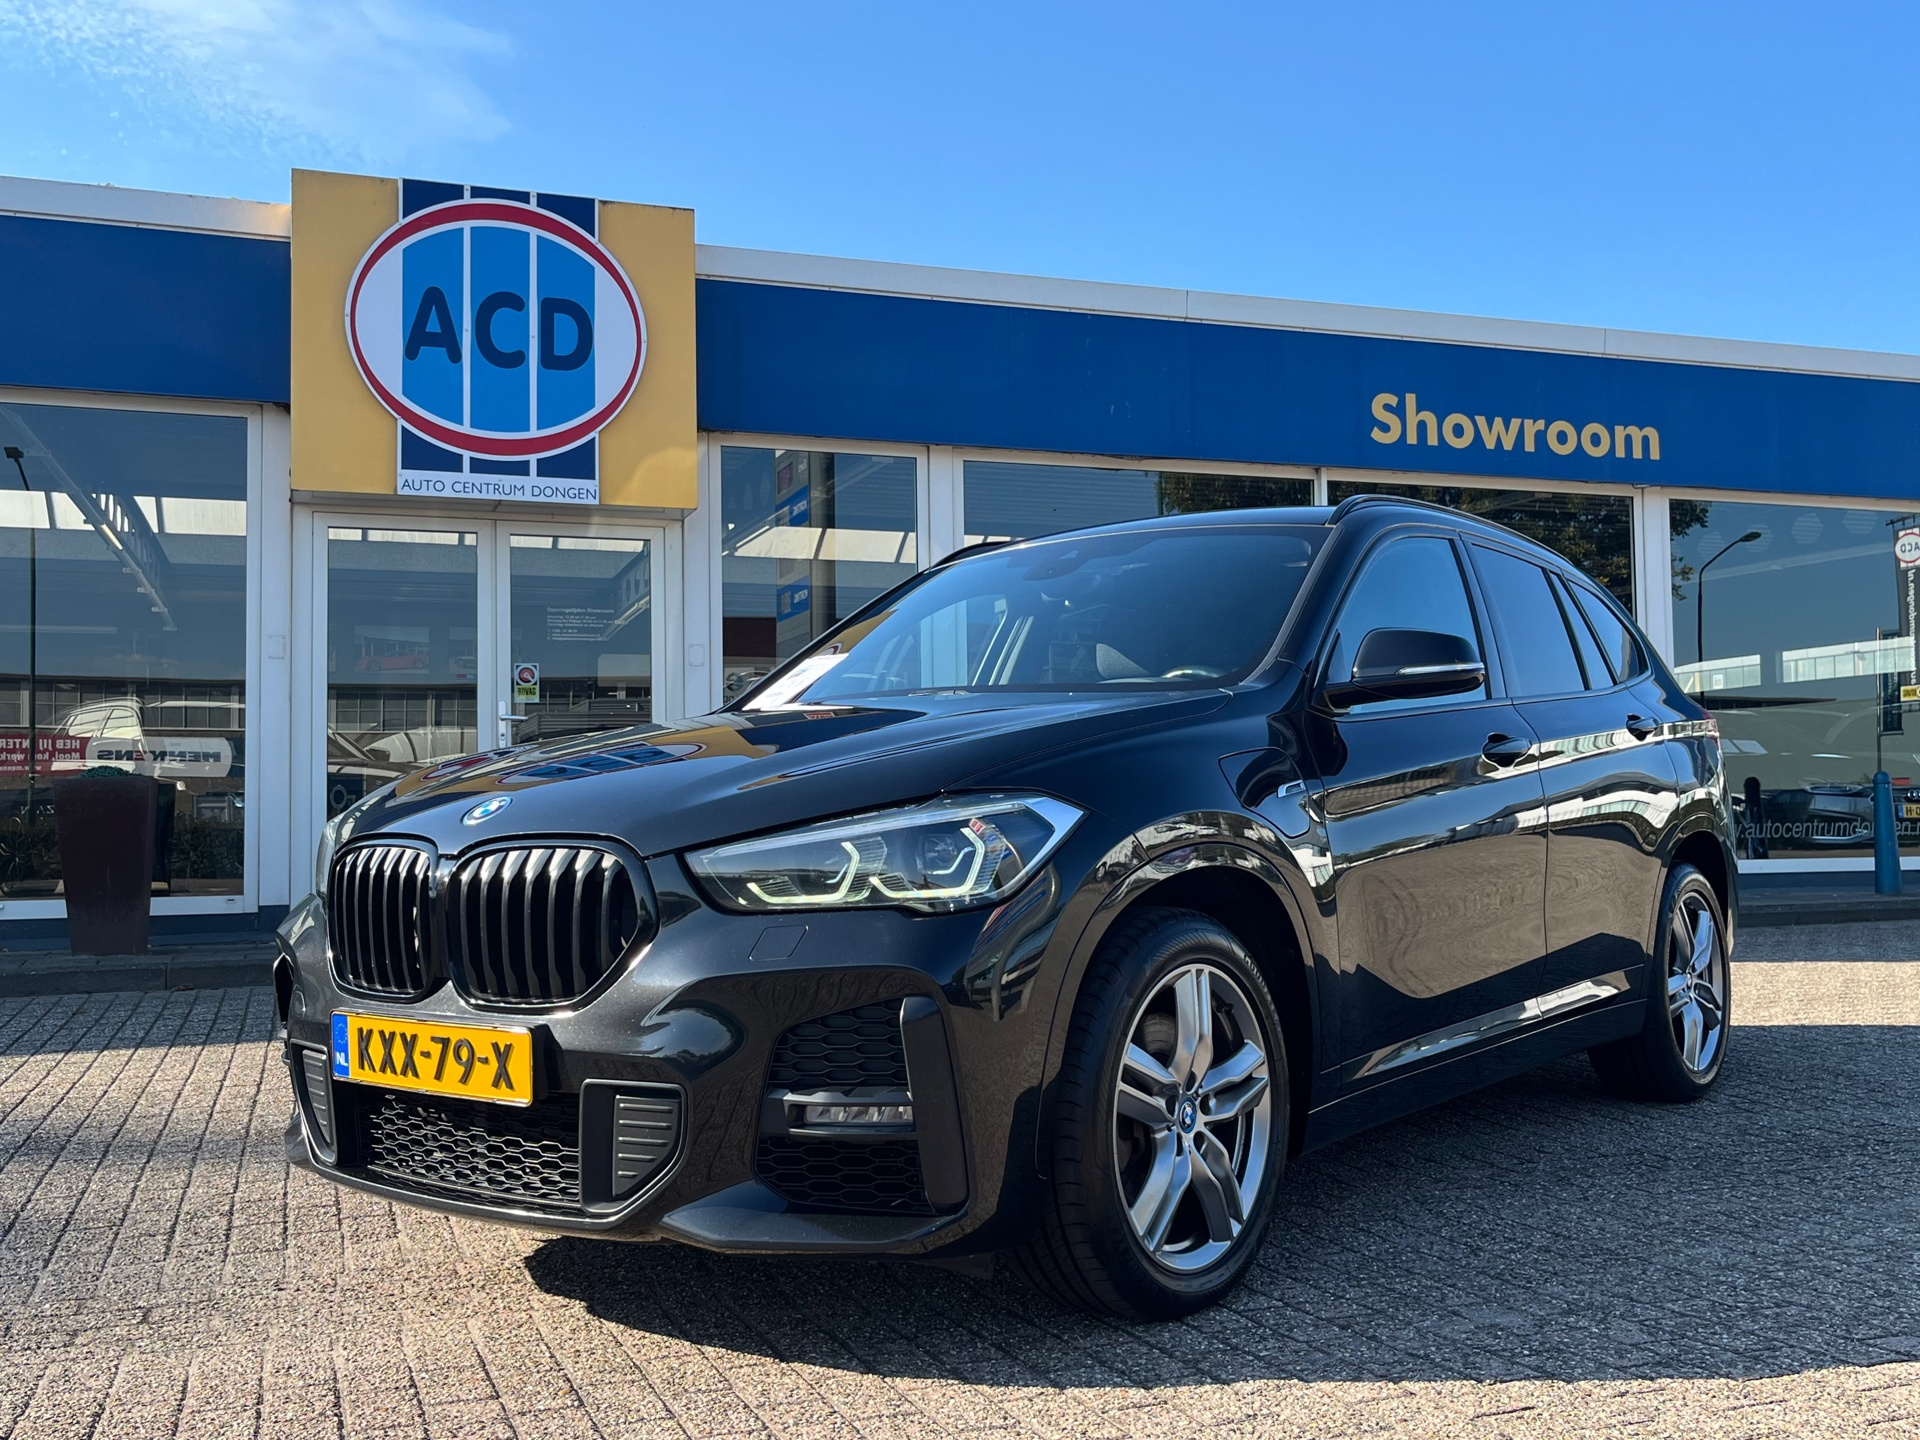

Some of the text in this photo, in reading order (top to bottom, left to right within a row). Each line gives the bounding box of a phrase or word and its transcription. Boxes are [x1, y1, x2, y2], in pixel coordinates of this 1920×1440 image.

[404, 286, 593, 371] ACD
[1370, 393, 1660, 460] Showroom
[401, 478, 597, 501] AUTO CENTRUM DONGEN
[336, 1052, 349, 1066] NL
[357, 1026, 516, 1091] KXX-79-X
